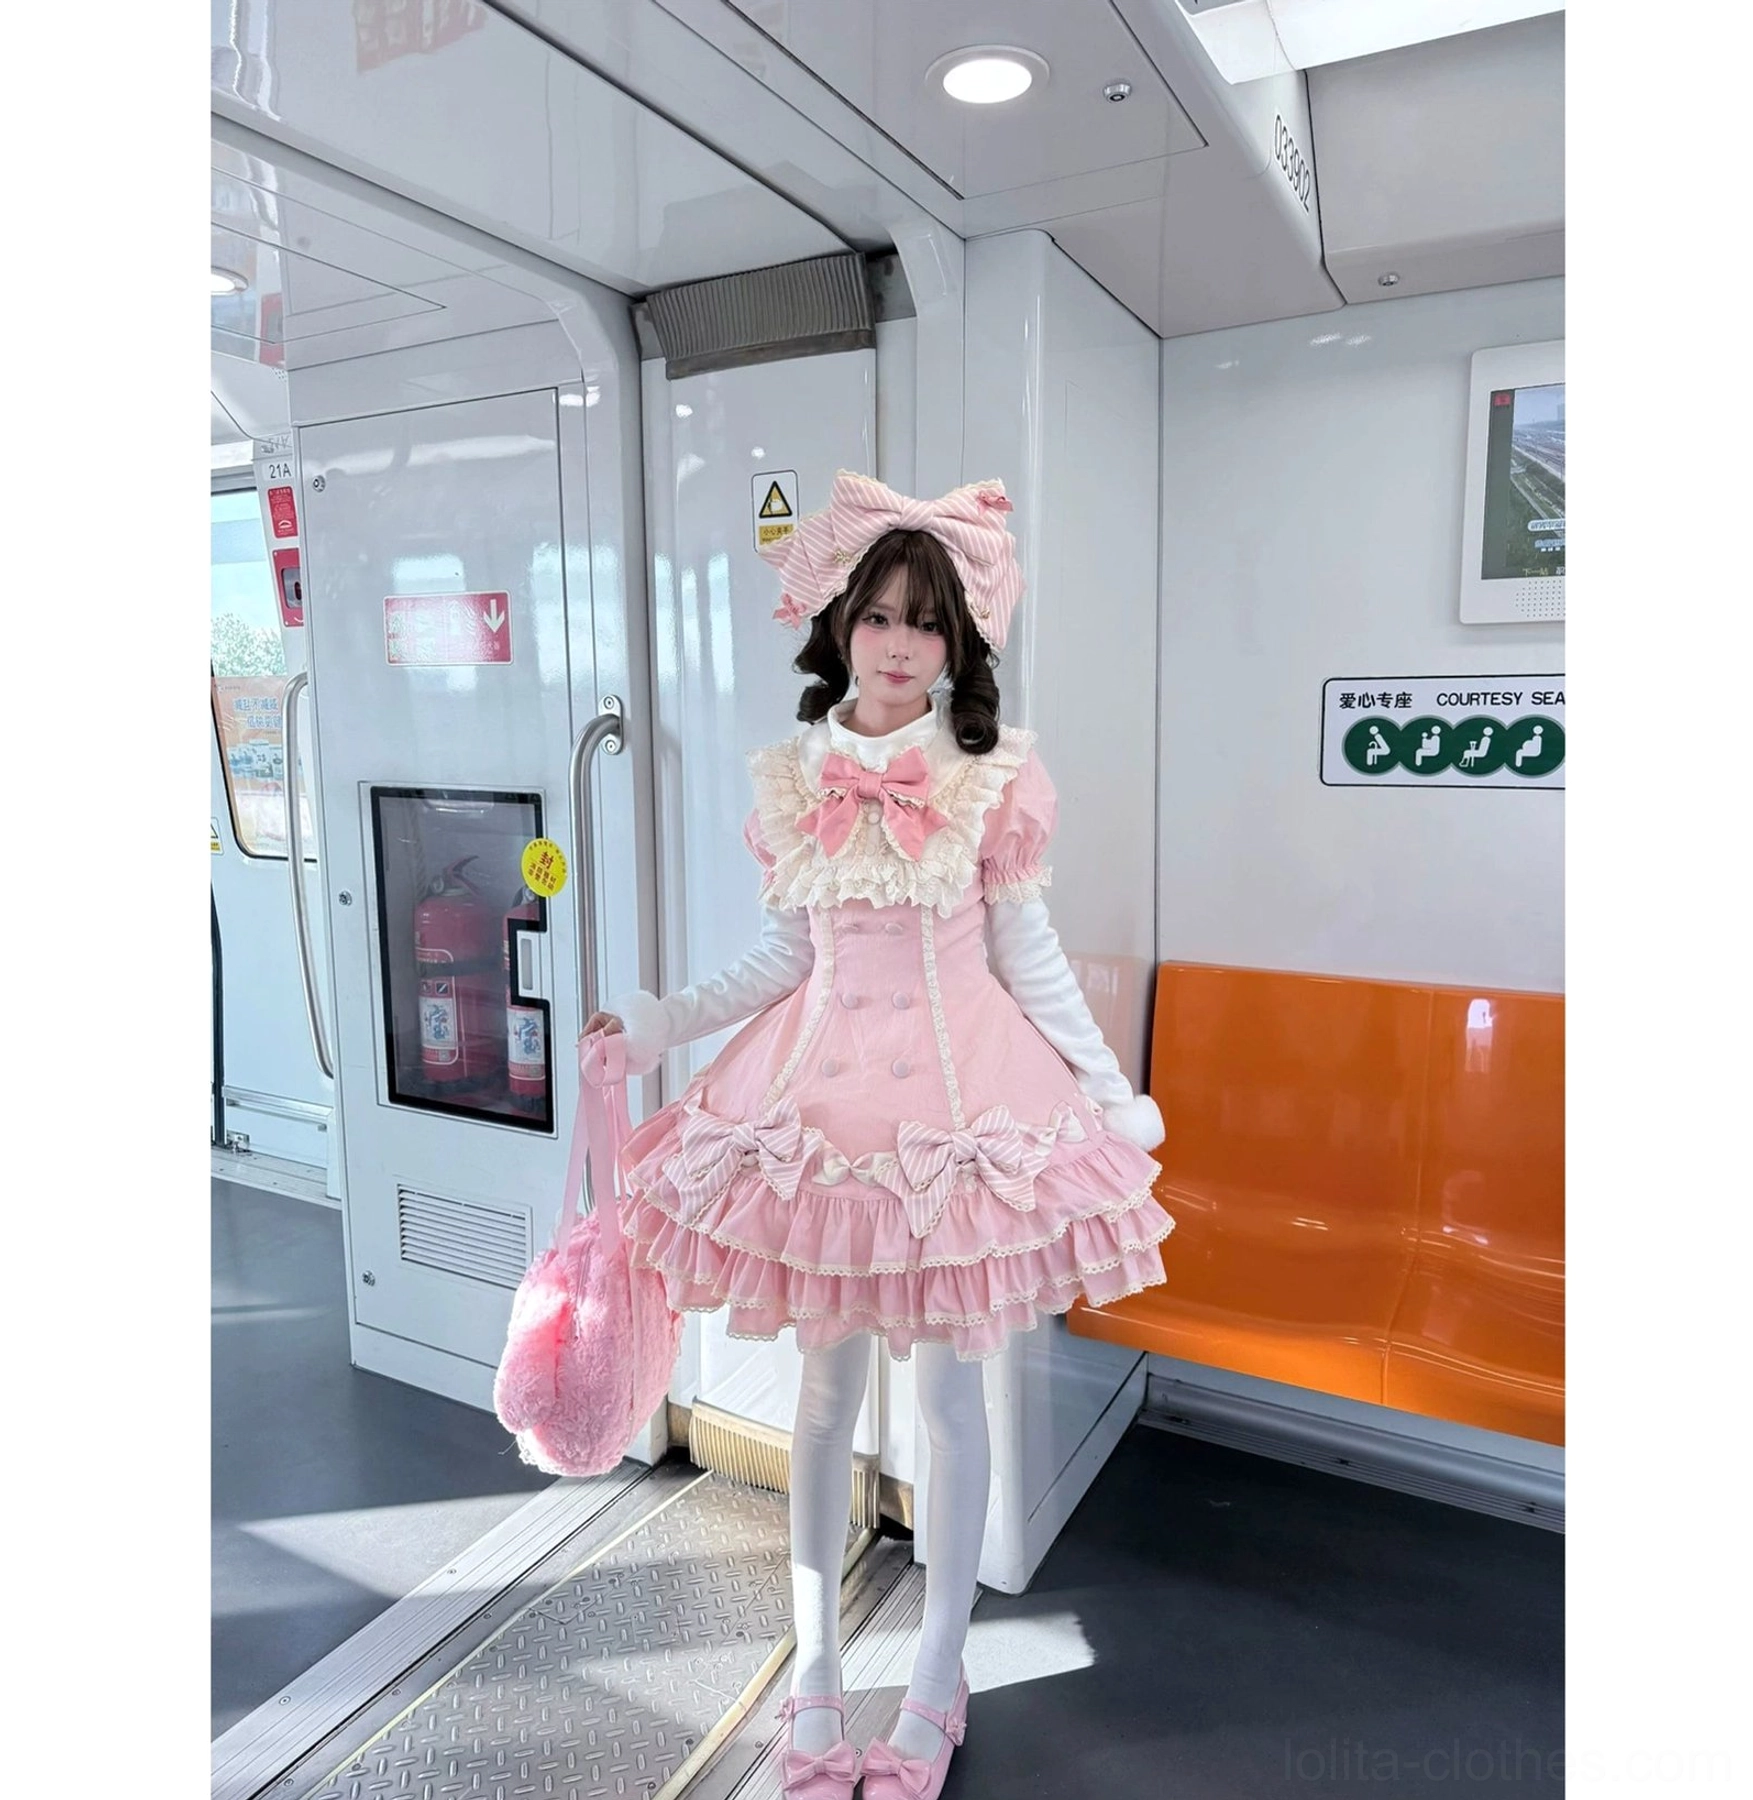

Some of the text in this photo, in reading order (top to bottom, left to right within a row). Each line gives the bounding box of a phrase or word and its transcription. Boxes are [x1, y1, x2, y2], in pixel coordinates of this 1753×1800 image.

[1274, 114, 1310, 212] 033902
[269, 463, 292, 479] 21A
[1339, 691, 1413, 709] 爱心专座
[1436, 691, 1523, 707] COURTESY
